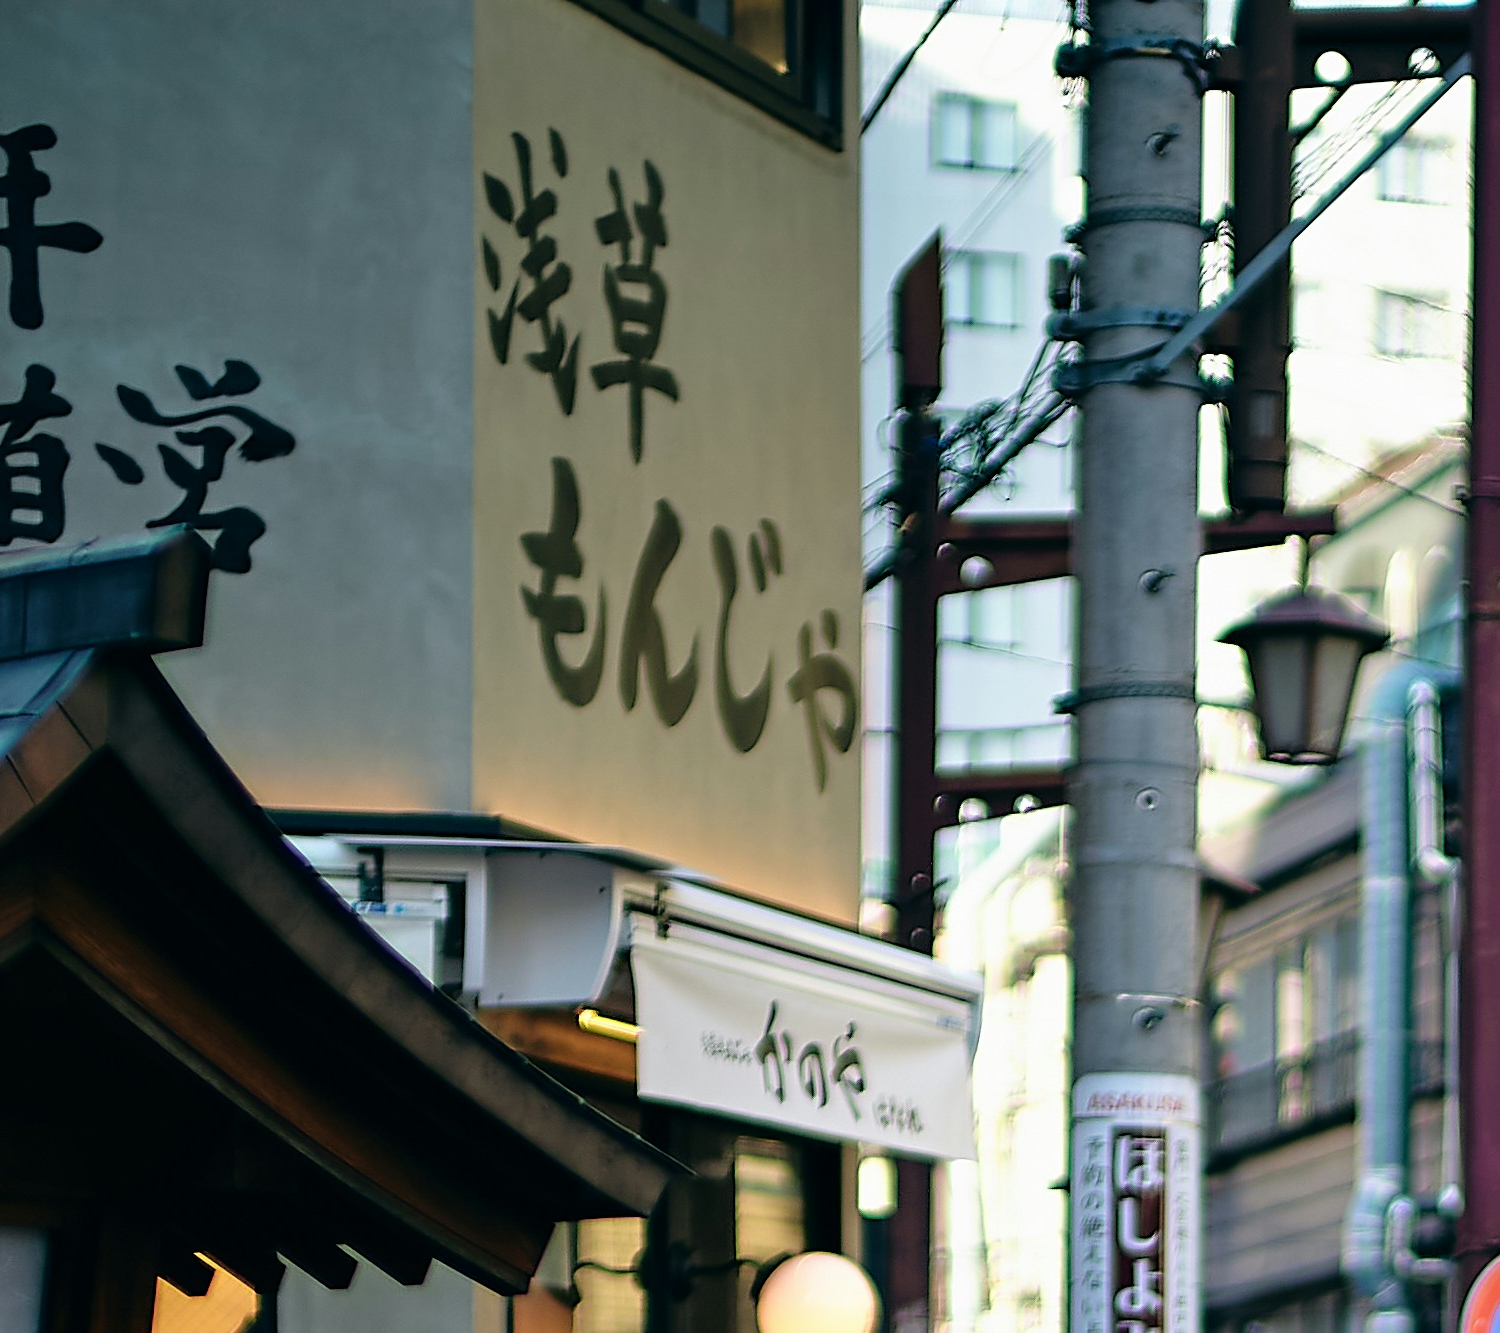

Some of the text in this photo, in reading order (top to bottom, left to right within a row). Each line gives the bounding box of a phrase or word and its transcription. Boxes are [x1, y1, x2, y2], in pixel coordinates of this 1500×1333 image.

[478, 128, 680, 465] 浅草
[518, 456, 856, 794] もんじゃ
